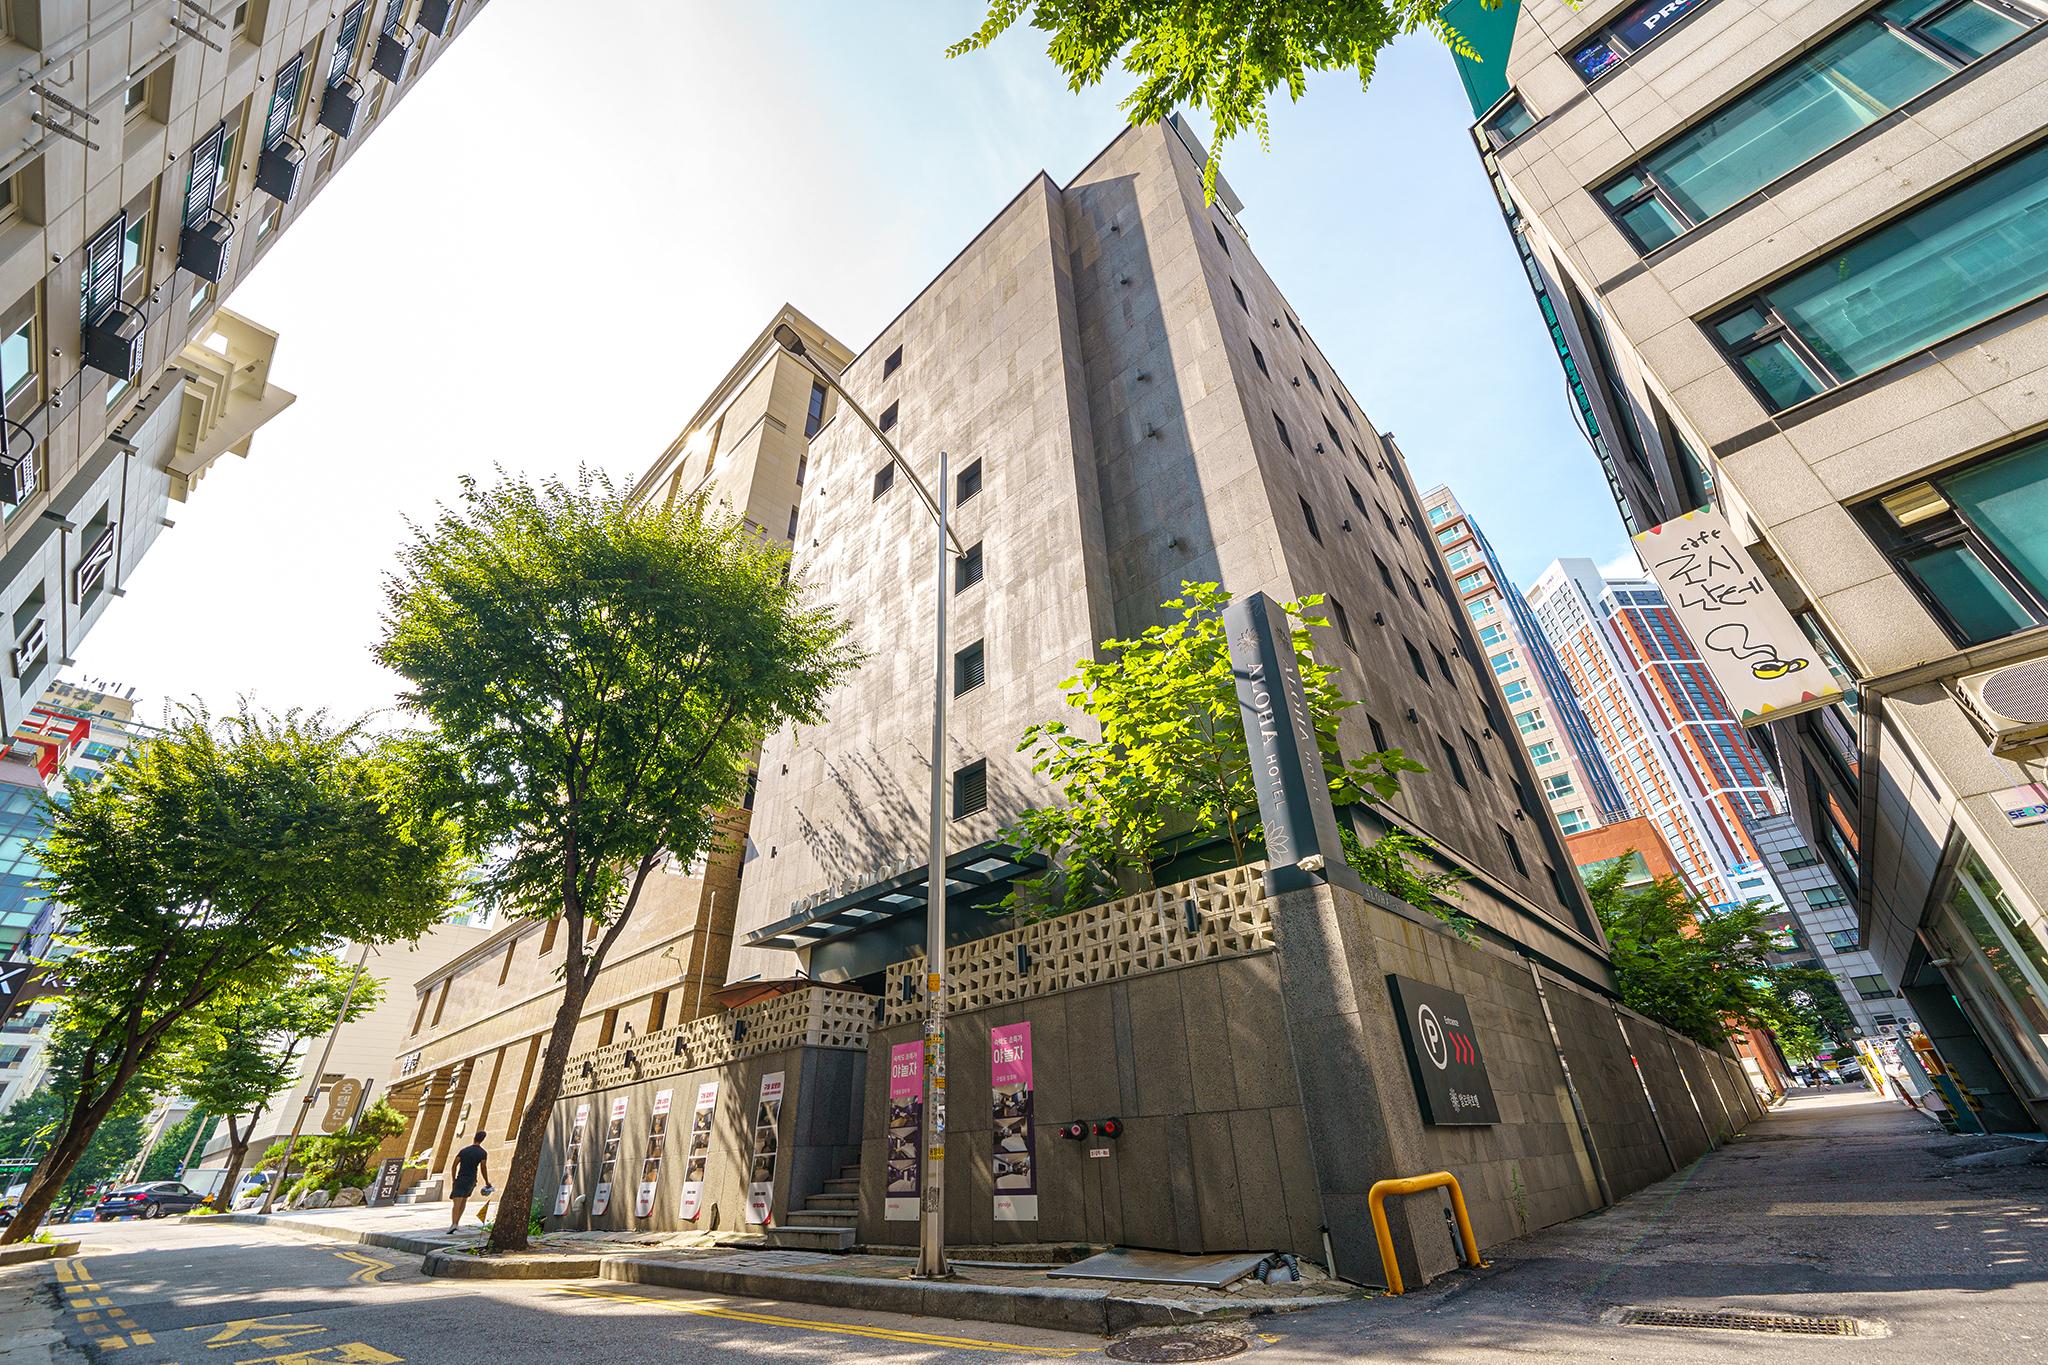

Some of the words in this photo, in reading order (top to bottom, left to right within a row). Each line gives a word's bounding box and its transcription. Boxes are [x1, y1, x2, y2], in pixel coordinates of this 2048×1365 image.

[1247, 662, 1279, 747] ALOHA
[1264, 753, 1285, 811] HOTEL
[1424, 1018, 1439, 1053] P
[892, 1063, 918, 1079] 야놀자
[993, 1045, 1024, 1064] 야놀자
[332, 1083, 354, 1120] 호텔진
[381, 1164, 398, 1198] 호텔진
